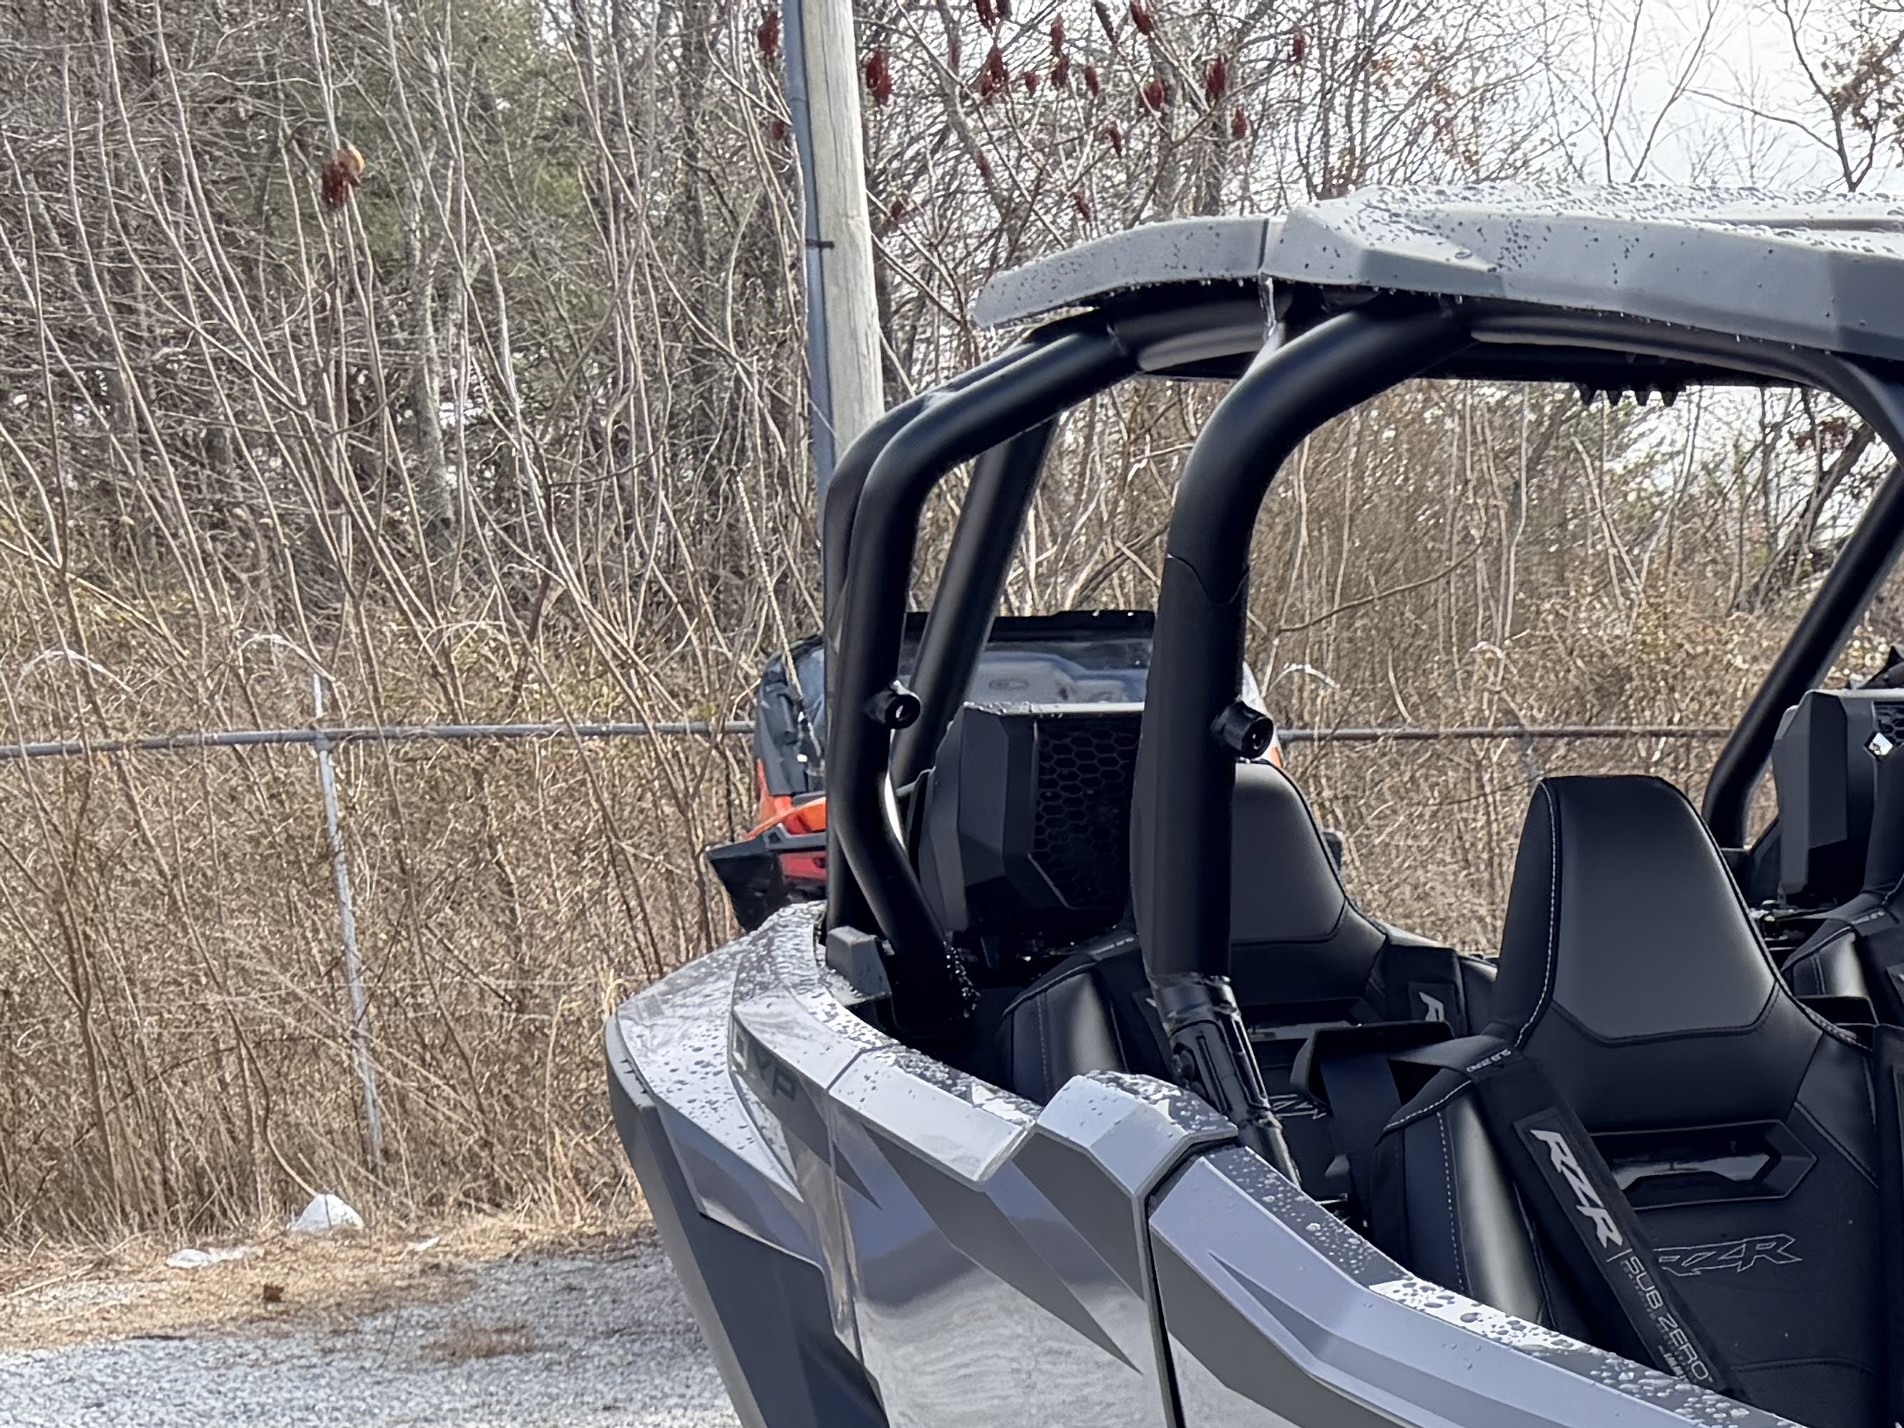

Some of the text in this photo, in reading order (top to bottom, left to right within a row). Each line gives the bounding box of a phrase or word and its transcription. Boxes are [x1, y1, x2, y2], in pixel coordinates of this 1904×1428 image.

[1530, 1129, 1623, 1249] RZR
[1624, 1255, 1664, 1310] SUB
[1657, 1313, 1709, 1381] ZERO
[1652, 1233, 1803, 1277] RZR
